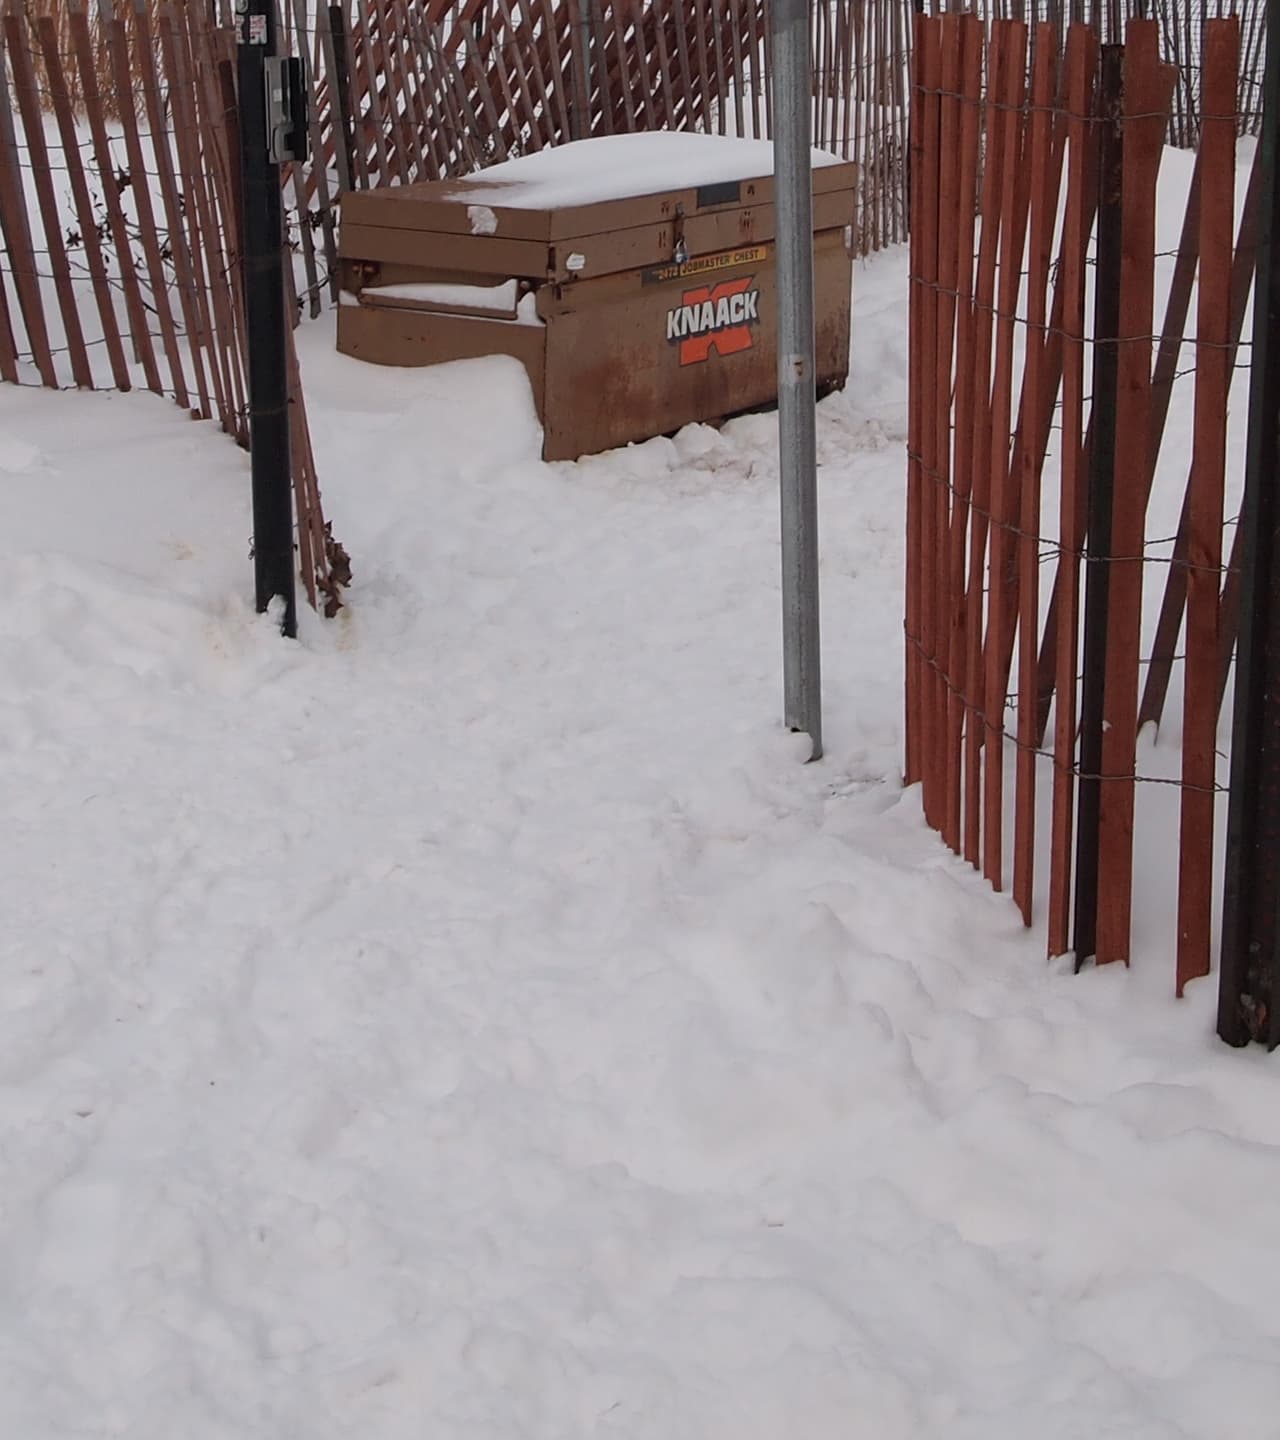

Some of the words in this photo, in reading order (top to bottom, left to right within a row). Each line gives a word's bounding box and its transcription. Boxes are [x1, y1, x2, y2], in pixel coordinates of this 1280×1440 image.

[682, 255, 730, 274] JOBMASTER
[733, 249, 759, 263] CHEST
[666, 290, 759, 340] KNAACK
